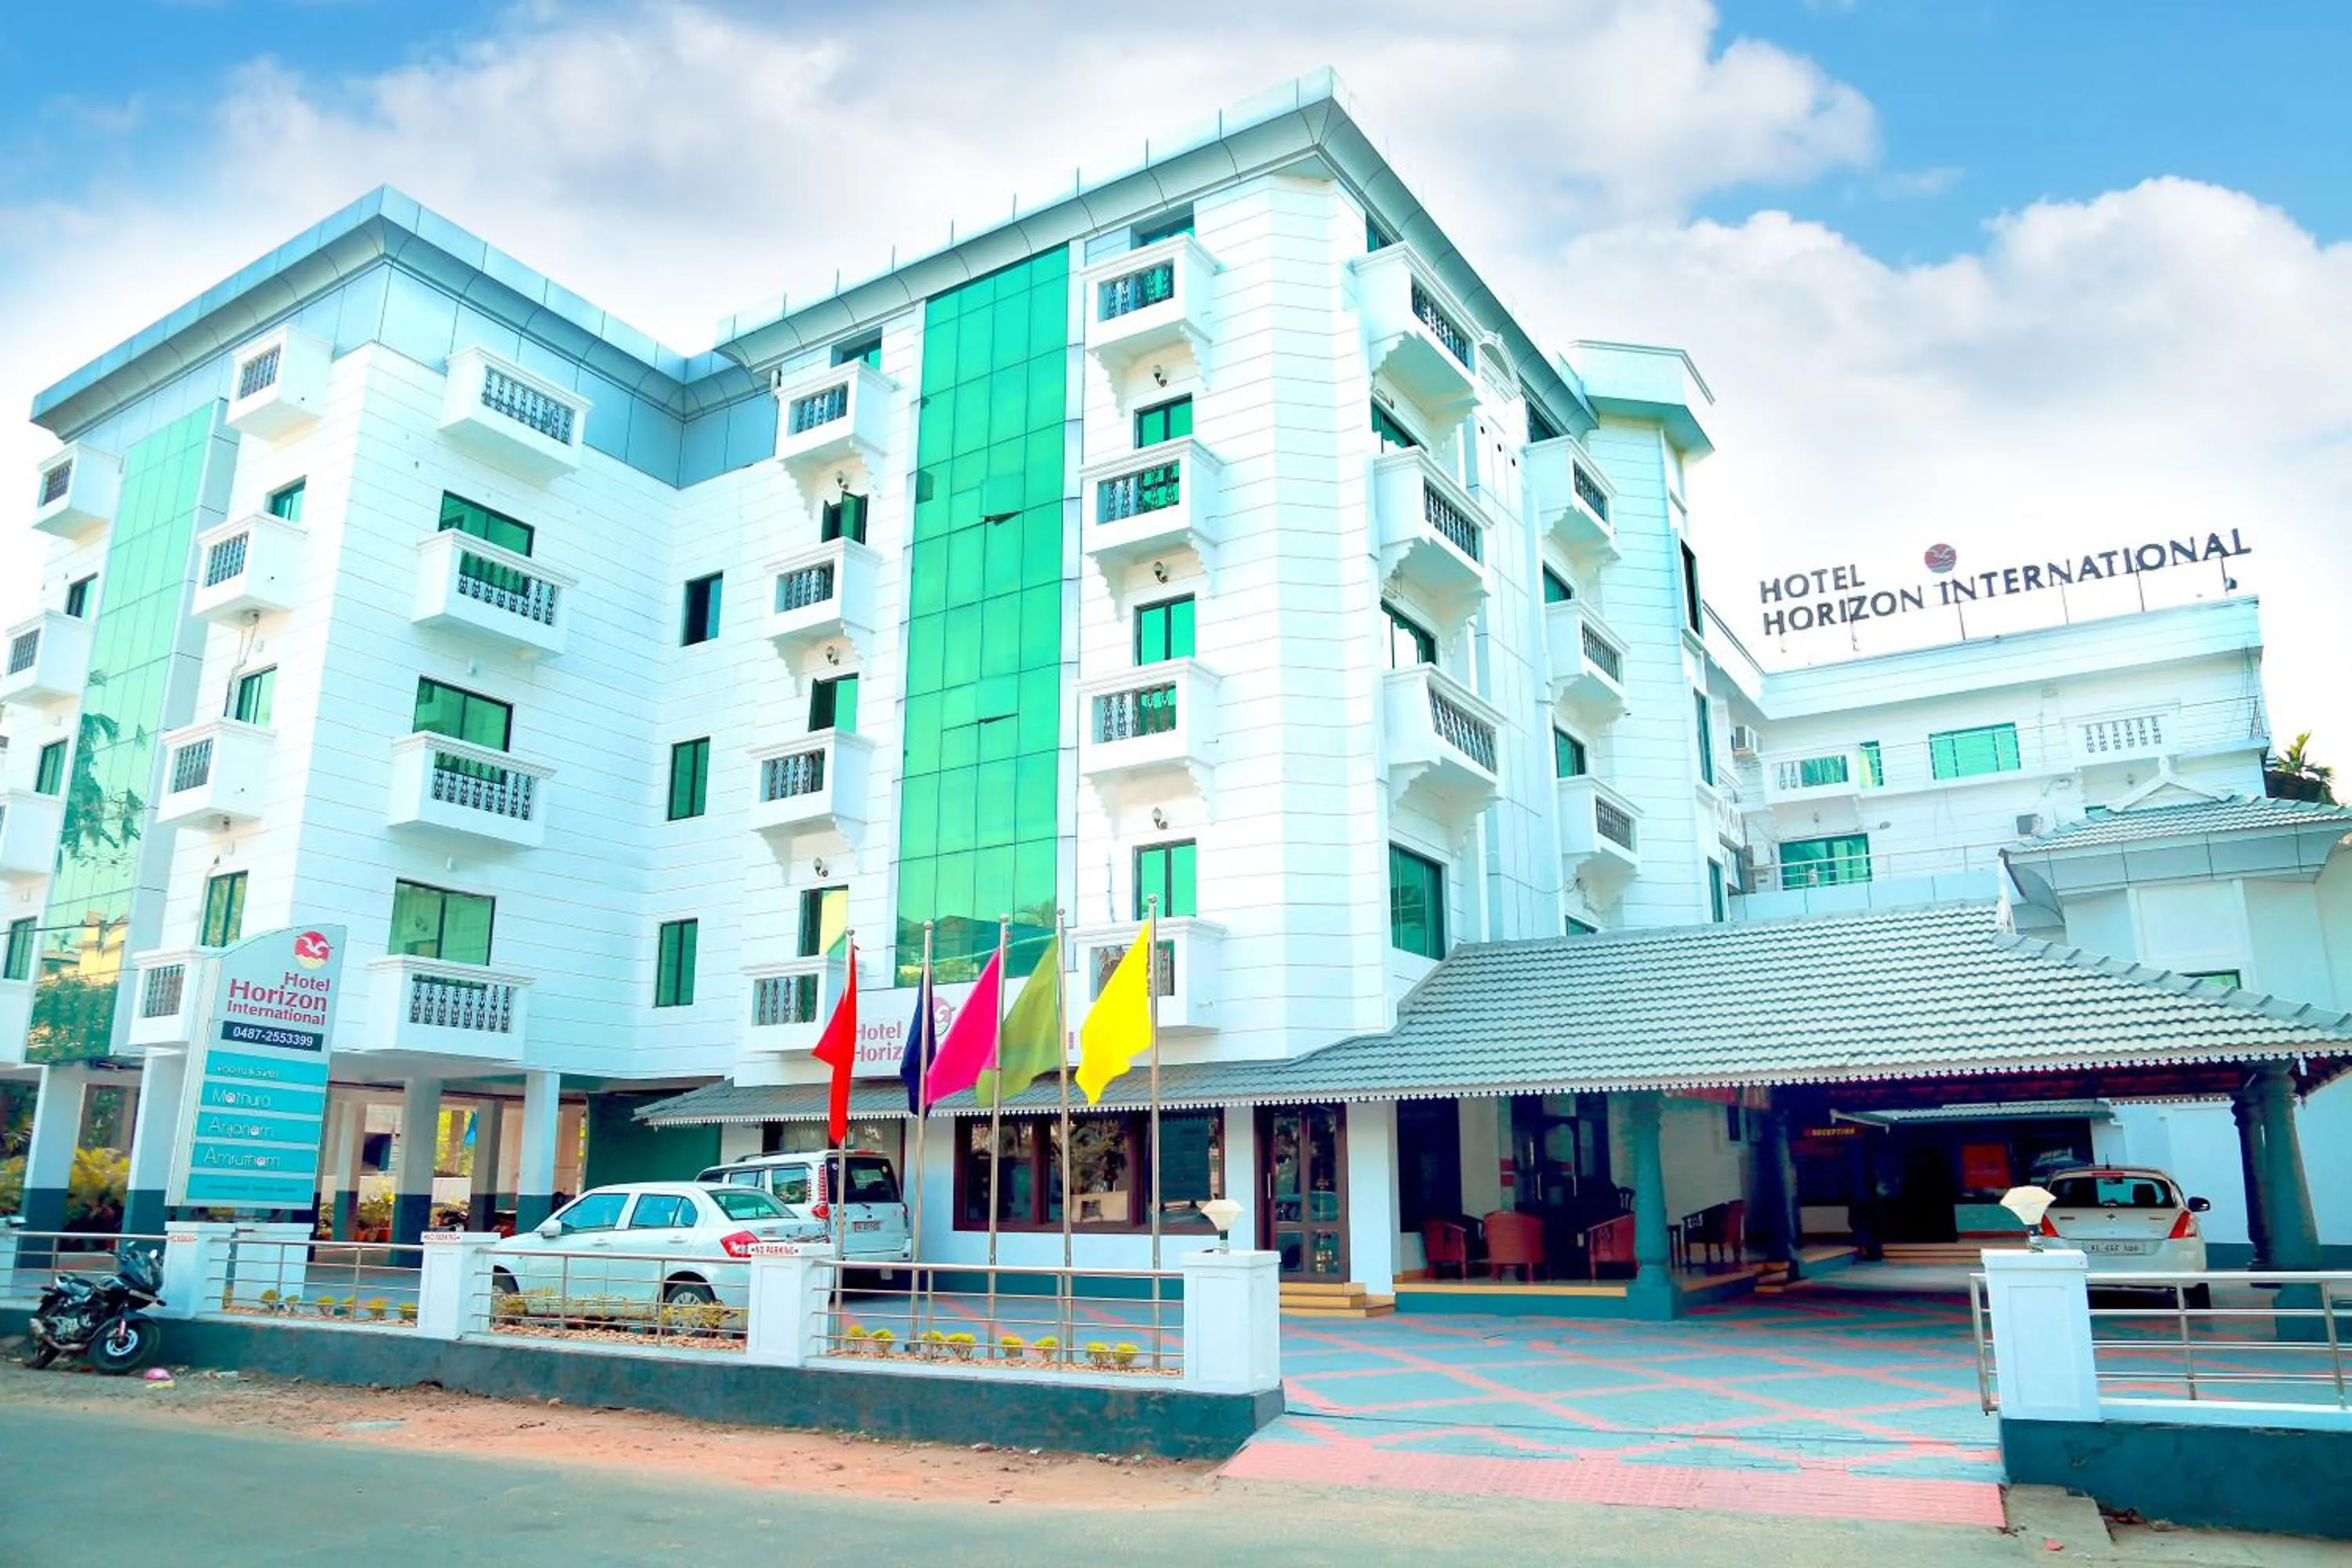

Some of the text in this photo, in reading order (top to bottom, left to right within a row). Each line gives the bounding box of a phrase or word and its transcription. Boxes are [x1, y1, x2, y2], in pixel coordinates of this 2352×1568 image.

[1760, 564, 1866, 604] HOTEL
[1764, 528, 2252, 636] HORIZON INTERNATIONAL
[285, 971, 331, 992] Hotel
[229, 978, 328, 1012] Horizon
[227, 1000, 326, 1026] International
[232, 1025, 314, 1047] 0487-2553399
[855, 1041, 904, 1062] Horiz
